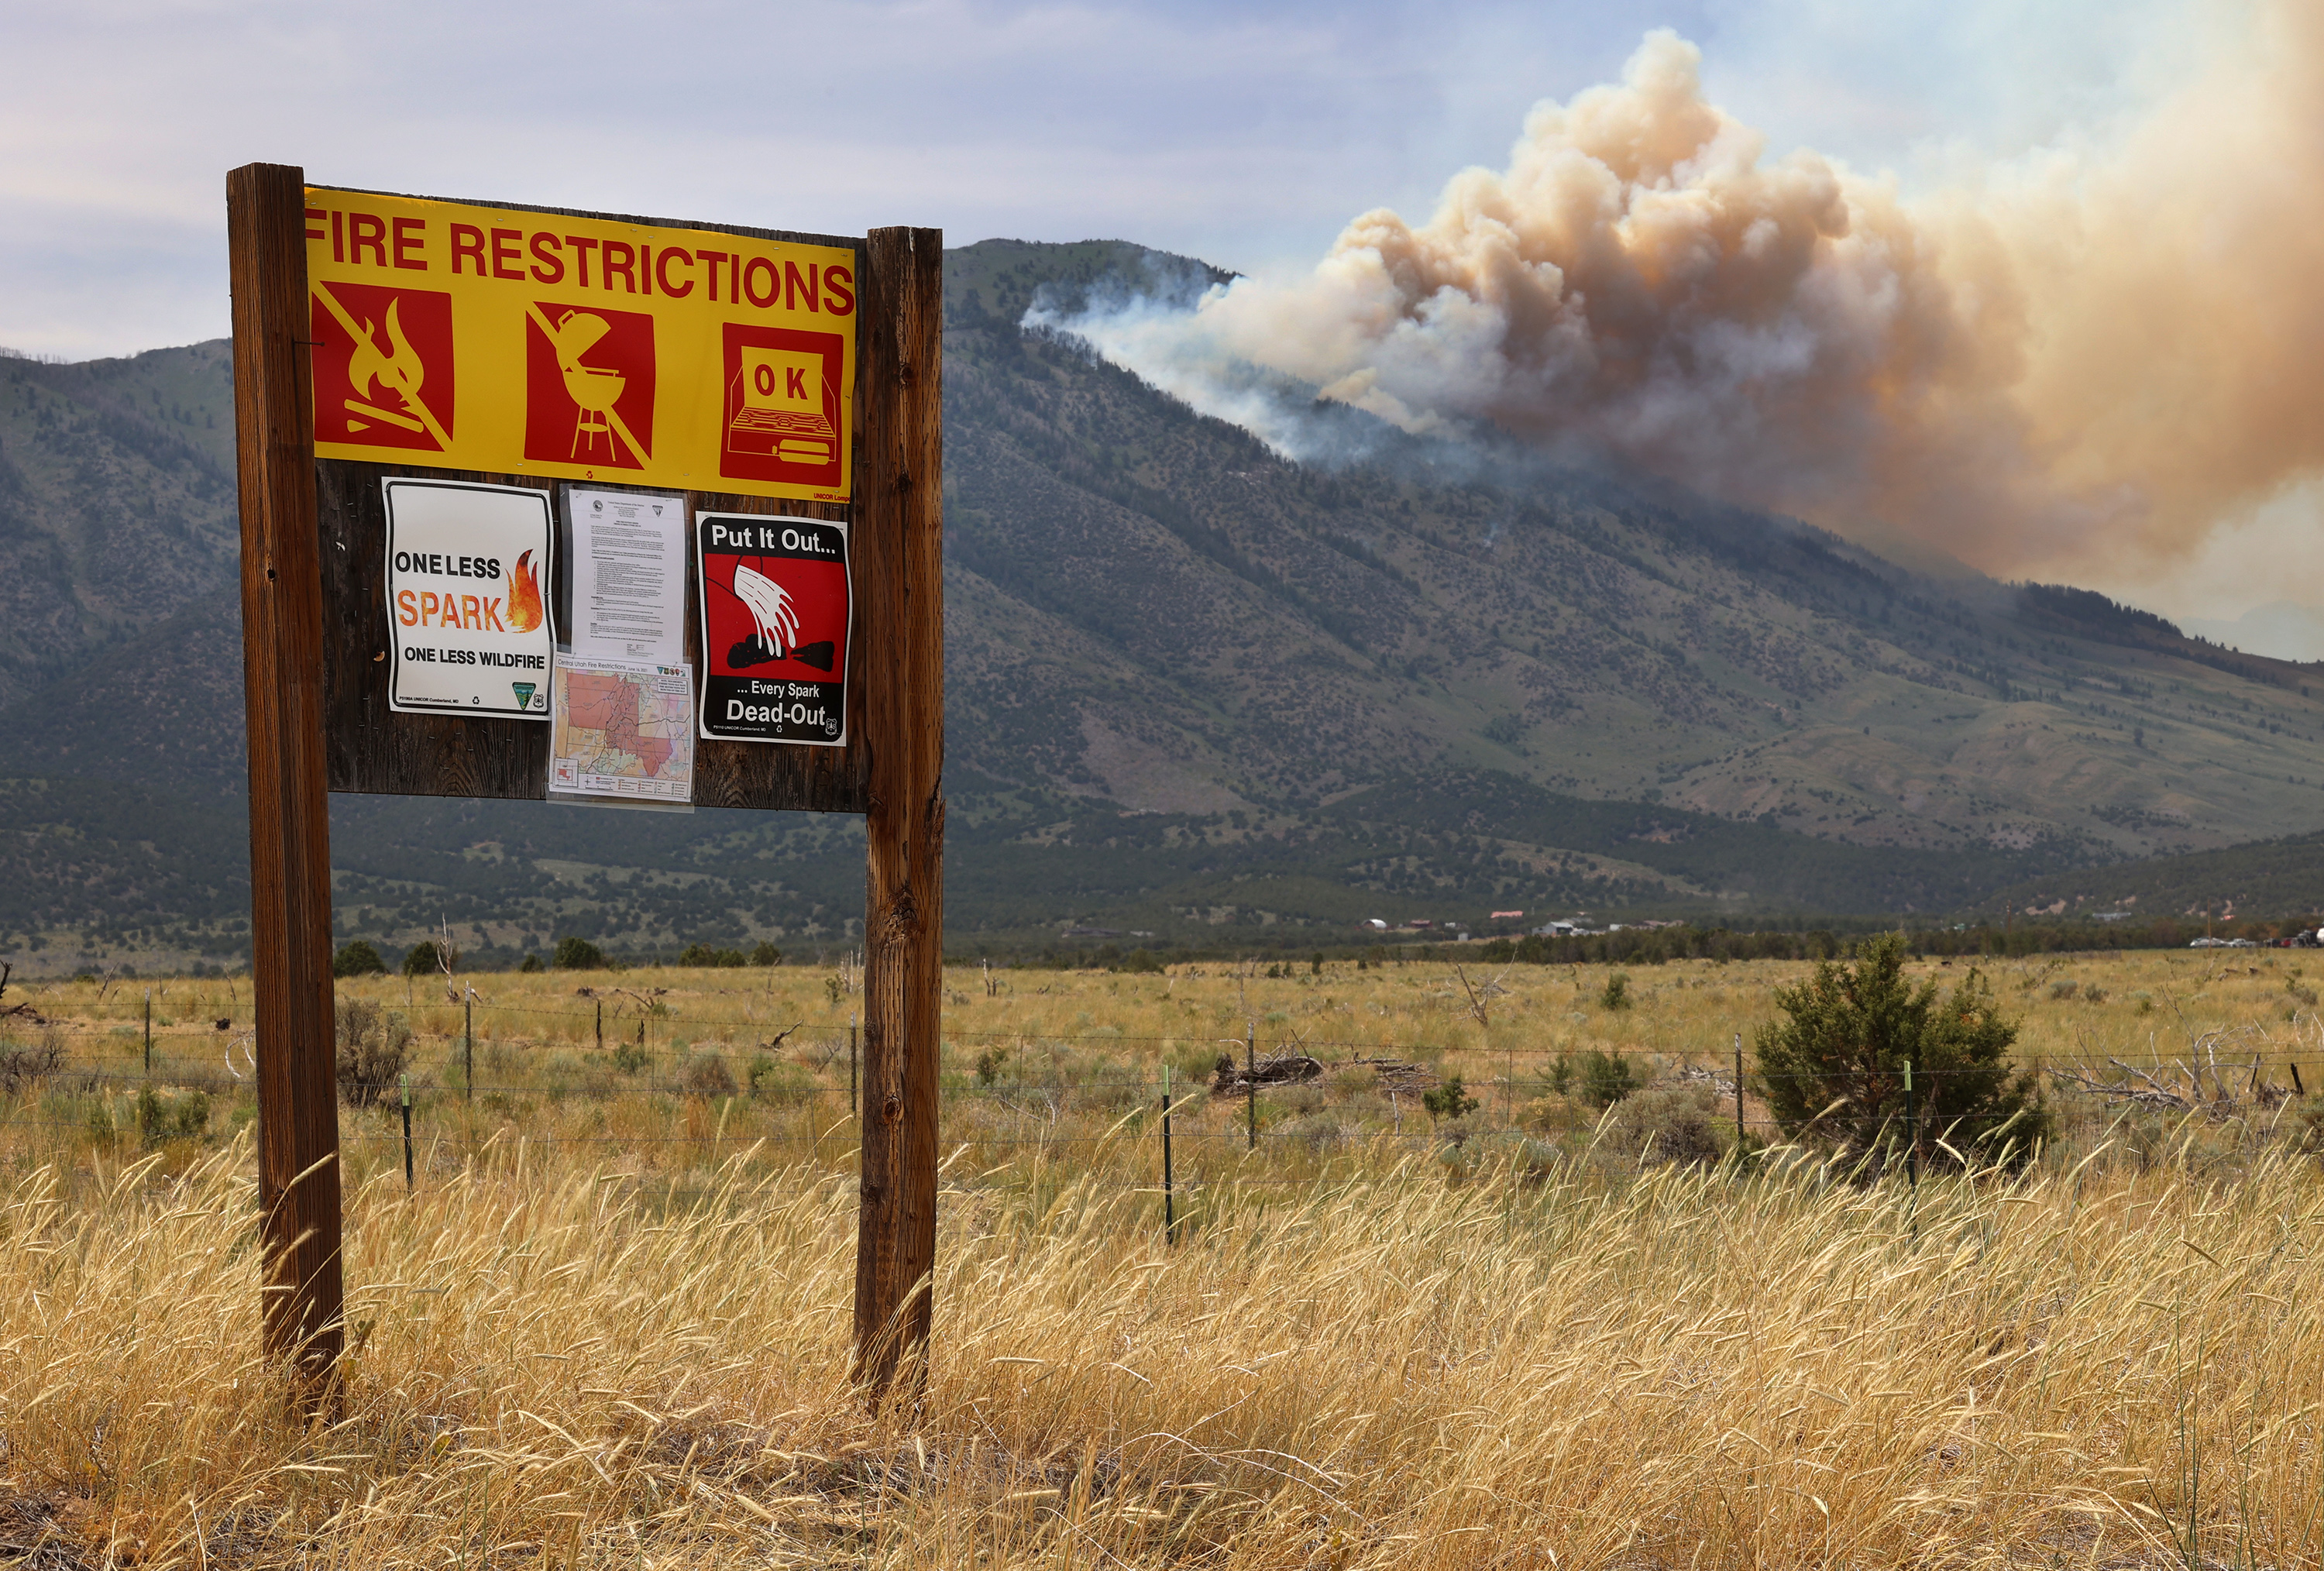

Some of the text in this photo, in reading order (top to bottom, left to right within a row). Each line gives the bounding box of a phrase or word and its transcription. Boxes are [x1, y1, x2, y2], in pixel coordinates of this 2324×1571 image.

[305, 208, 855, 316] FIRE RESTRICTIONS
[755, 363, 808, 400] OK
[711, 524, 836, 555] Put It Out...
[395, 552, 500, 579] ONE LESS
[397, 590, 505, 632] SPARK
[404, 647, 545, 669] ONE LESS WILDFIRE
[751, 681, 785, 699] Every
[788, 682, 820, 700] Spark
